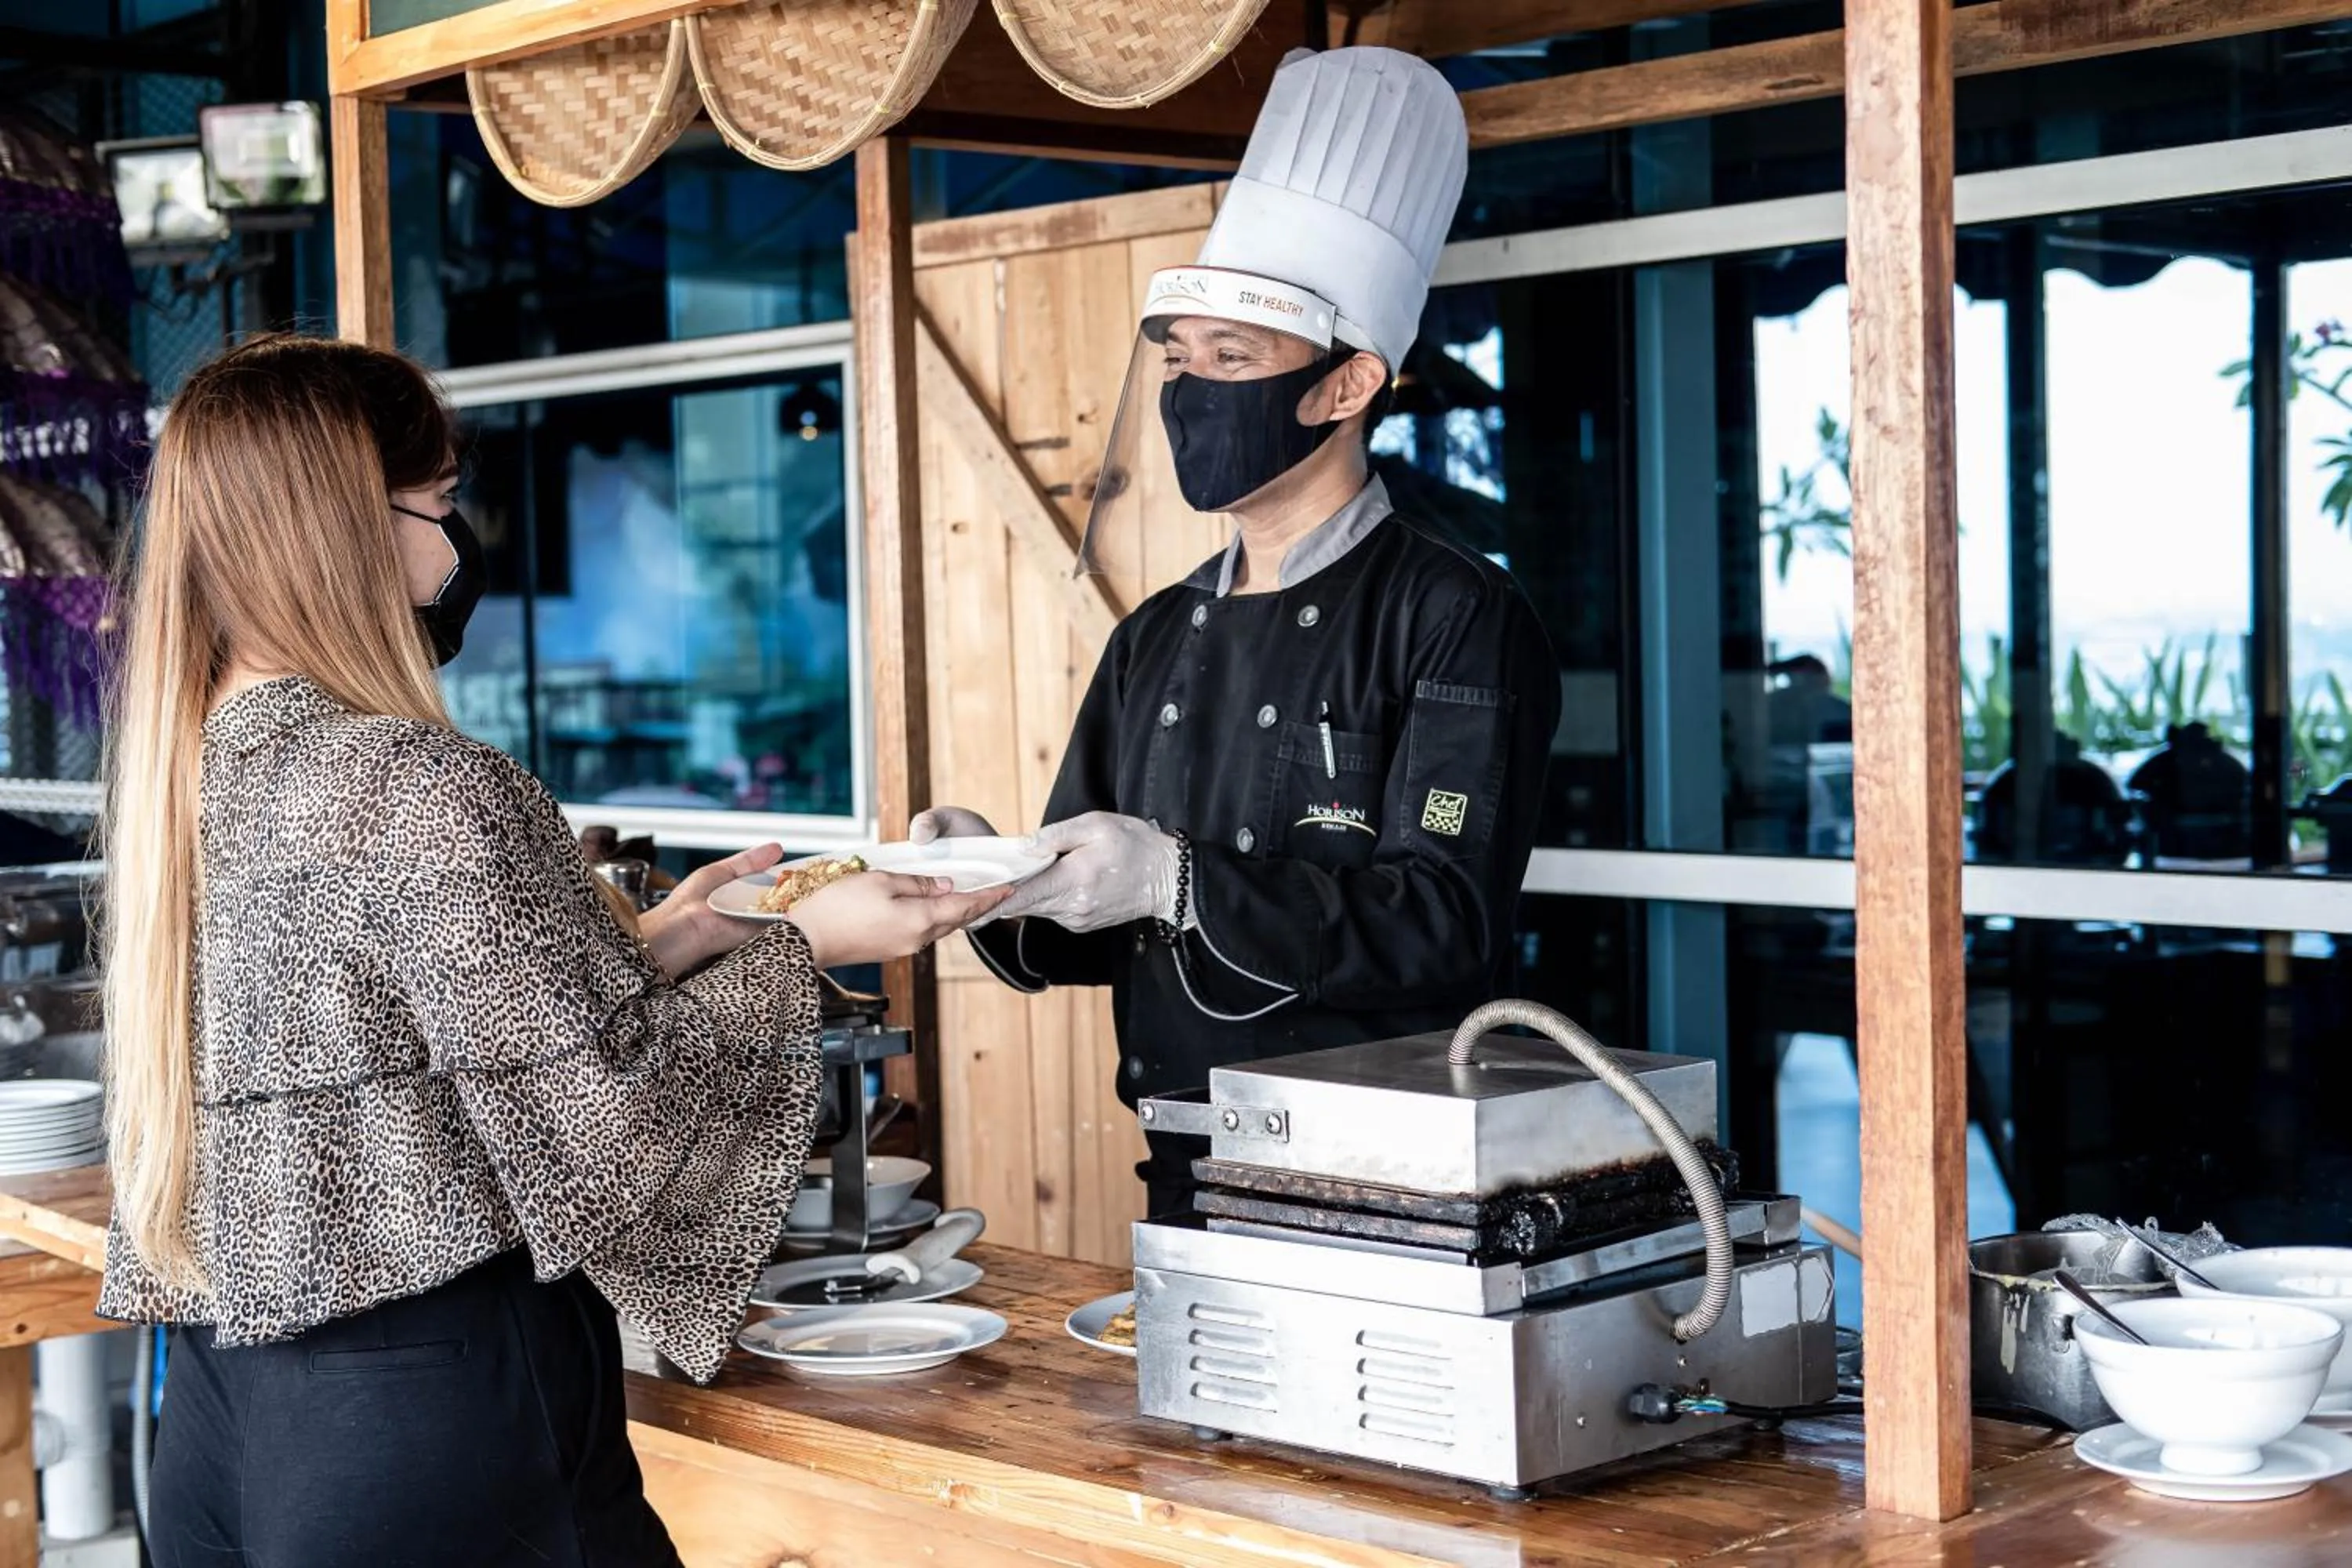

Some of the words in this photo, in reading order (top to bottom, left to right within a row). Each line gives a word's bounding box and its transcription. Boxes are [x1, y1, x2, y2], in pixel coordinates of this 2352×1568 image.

[1239, 291, 1263, 306] STAY
[1262, 296, 1304, 317] HEALTHY
[1431, 795, 1463, 811] Chef
